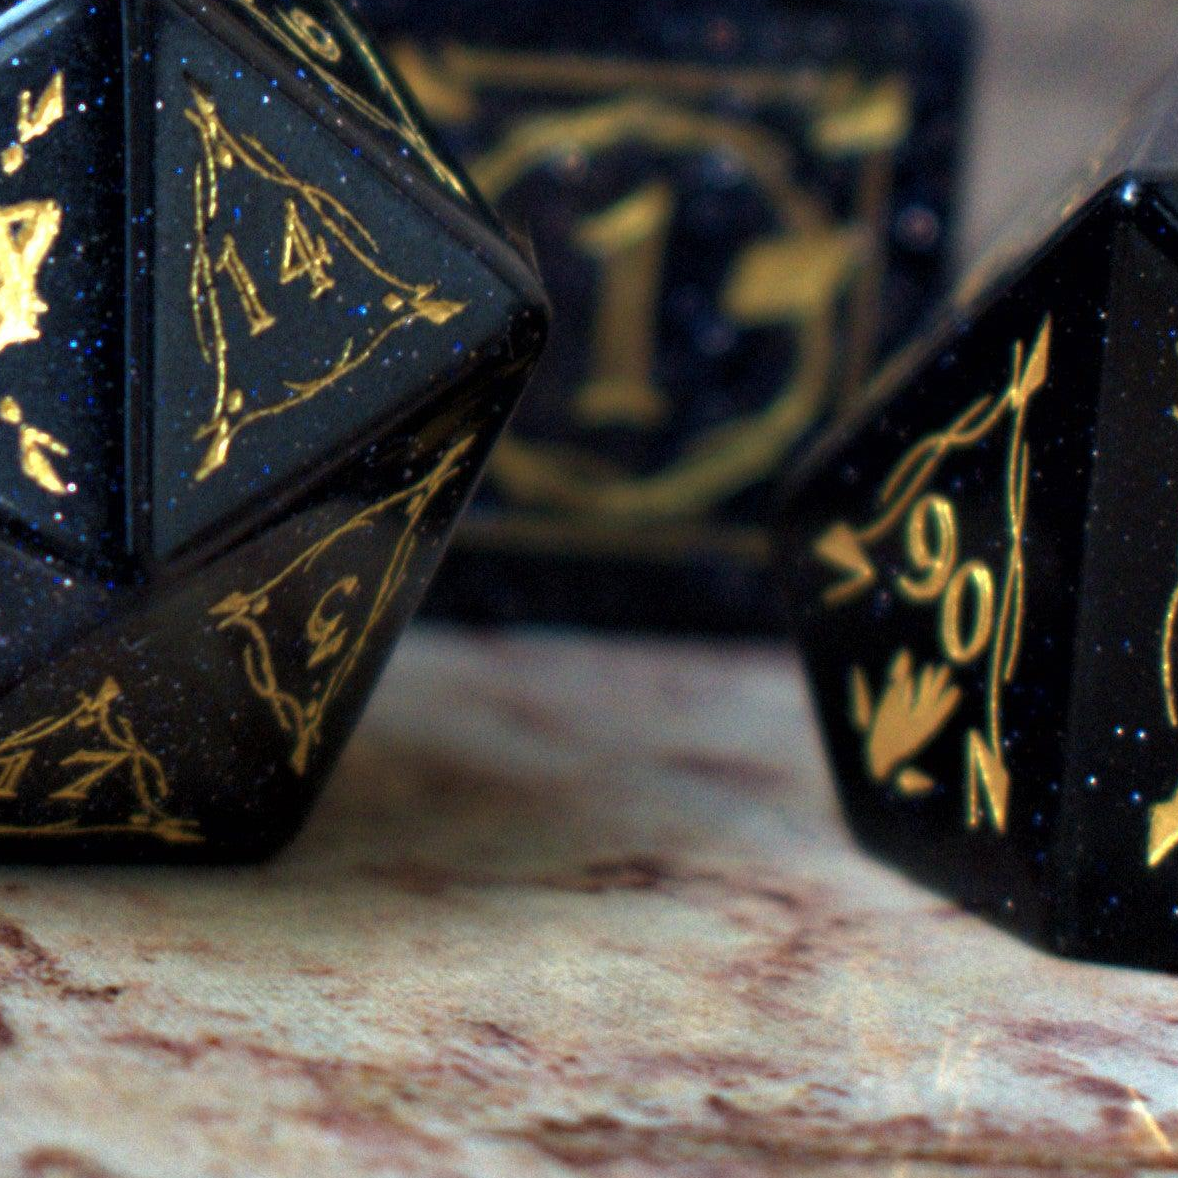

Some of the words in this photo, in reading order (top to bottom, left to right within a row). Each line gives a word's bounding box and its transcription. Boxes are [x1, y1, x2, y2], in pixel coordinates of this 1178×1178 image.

[215, 198, 335, 338] 14
[574, 180, 672, 425] 1
[898, 494, 995, 663] 90
